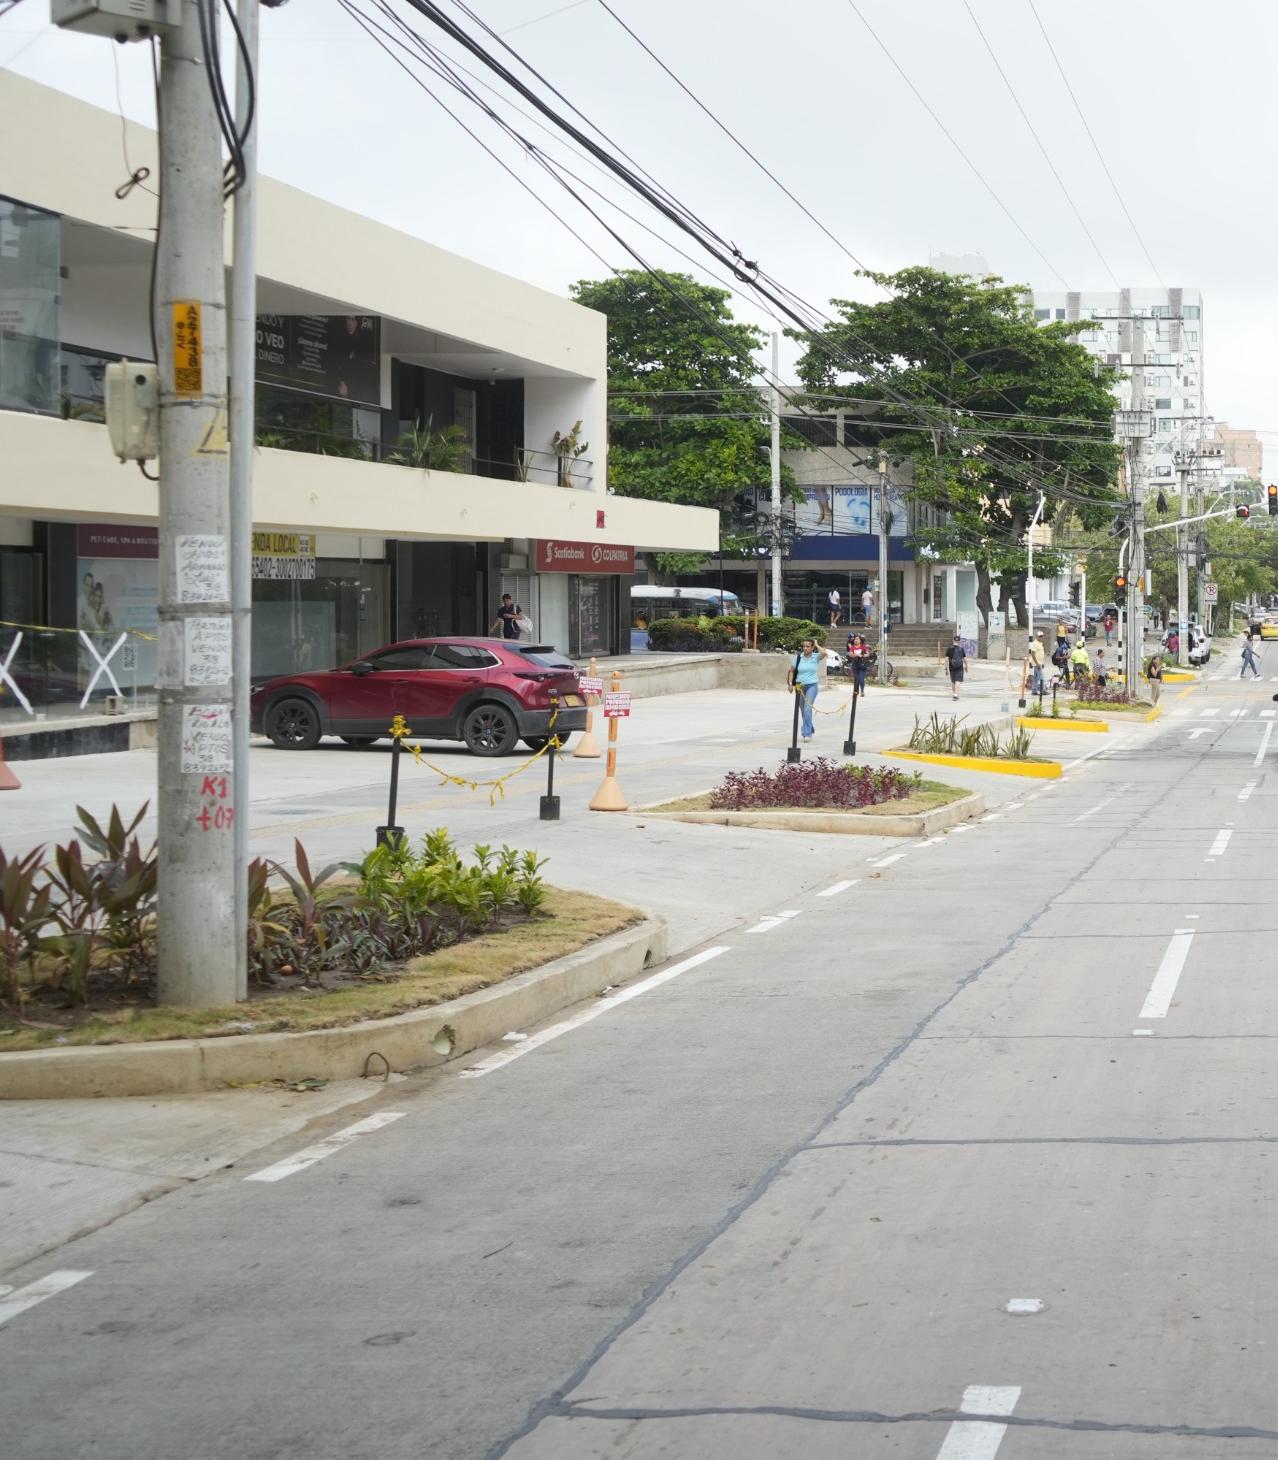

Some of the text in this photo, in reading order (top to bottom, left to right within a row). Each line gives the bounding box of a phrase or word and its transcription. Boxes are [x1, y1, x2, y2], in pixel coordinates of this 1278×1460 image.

[264, 331, 285, 349] VEO
[273, 533, 297, 553] LOCAL
[554, 546, 628, 561] Scotiabank COLPATRIA
